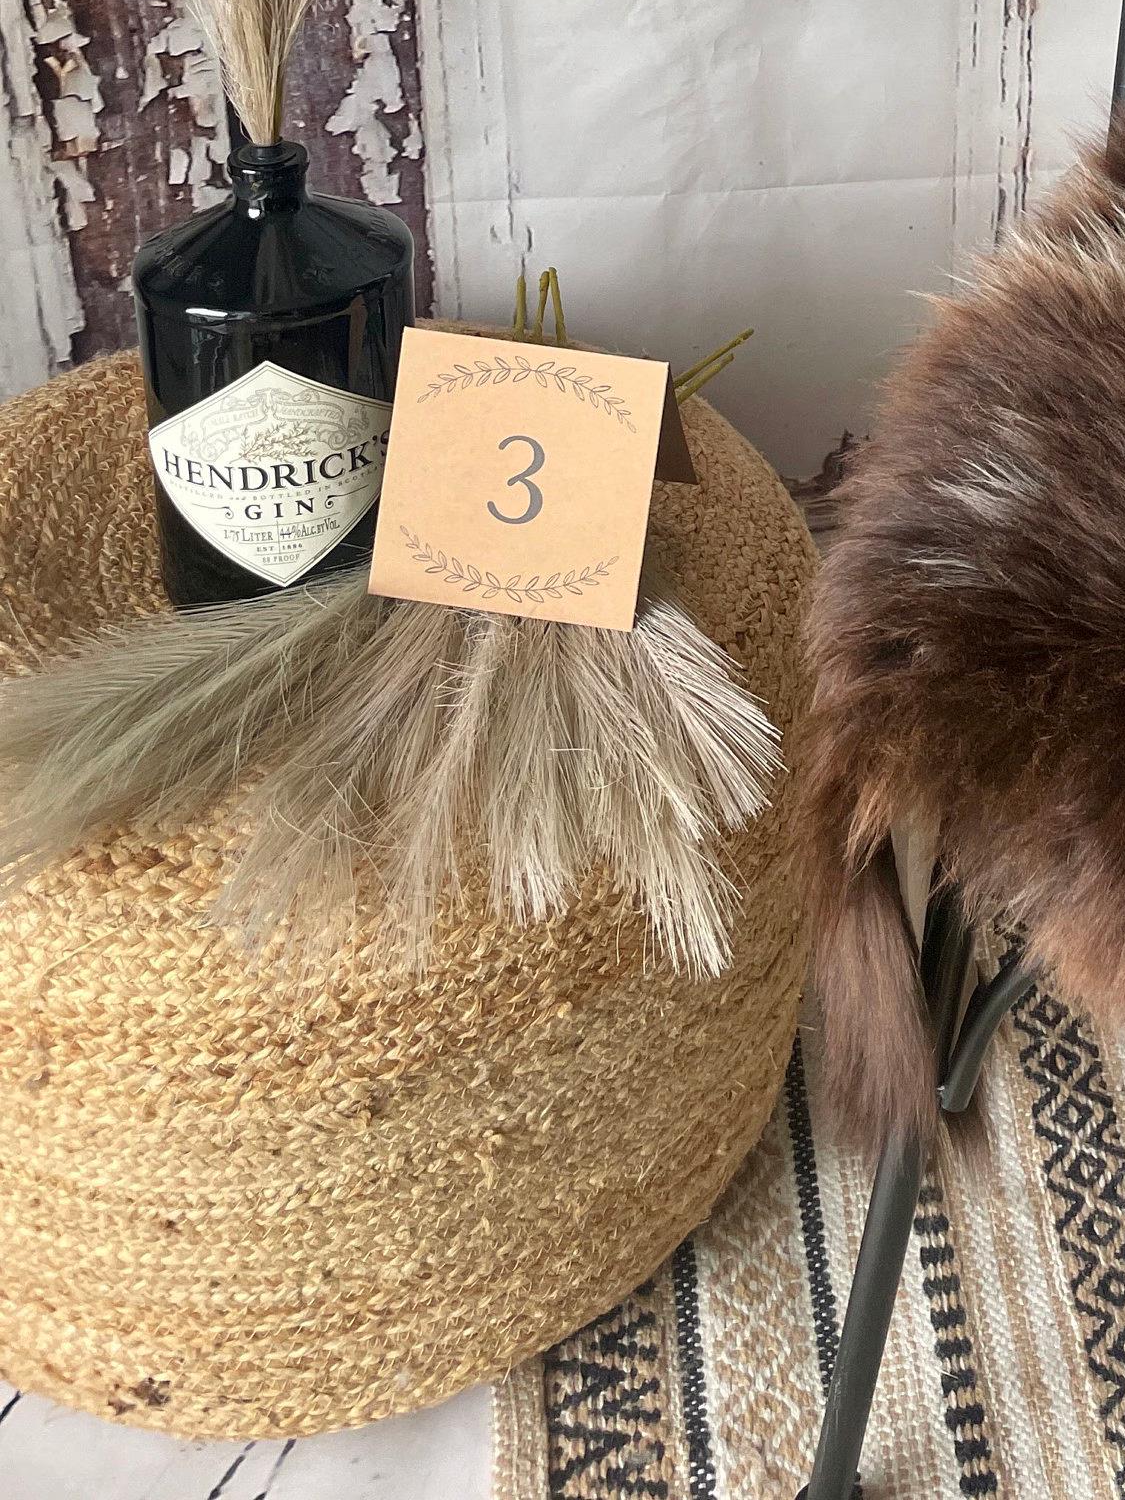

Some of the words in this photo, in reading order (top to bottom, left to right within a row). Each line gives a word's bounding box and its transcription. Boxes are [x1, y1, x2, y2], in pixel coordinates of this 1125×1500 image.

[486, 435, 546, 525] 3
[244, 497, 315, 521] GIN
[241, 528, 274, 542] LITER
